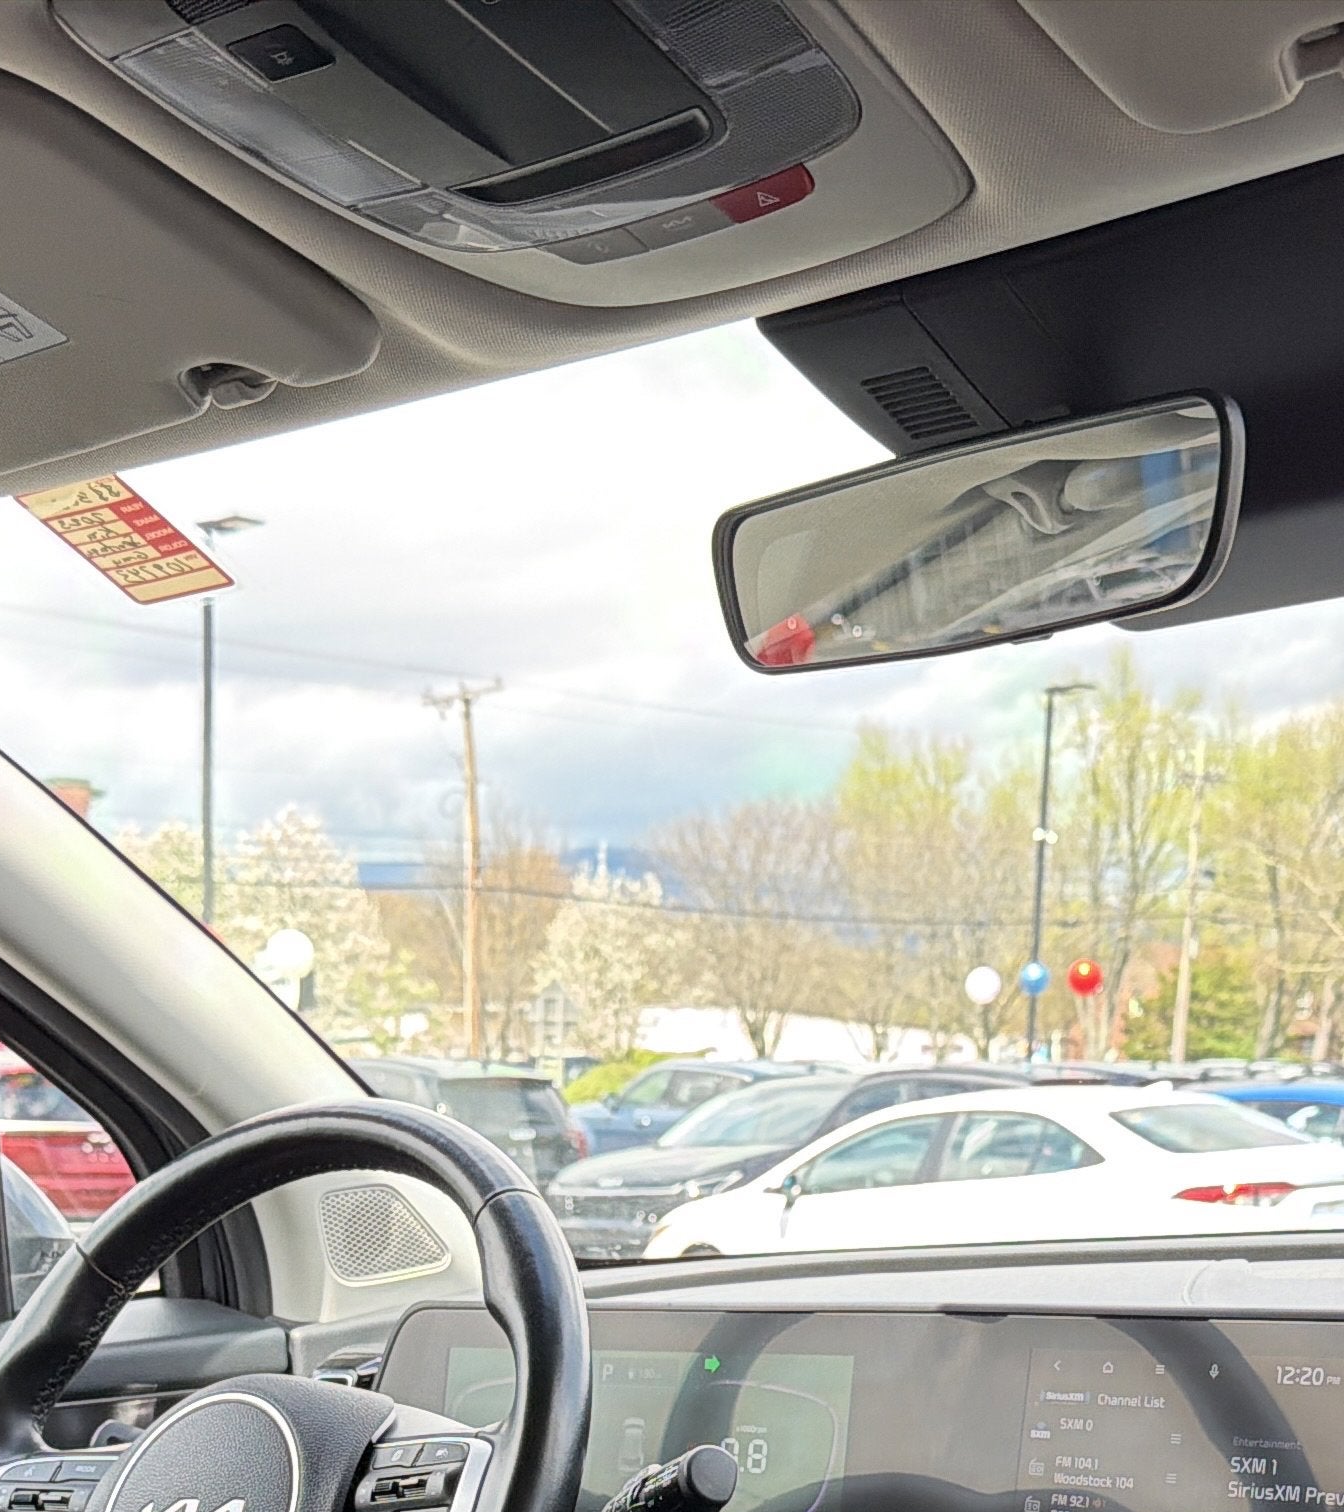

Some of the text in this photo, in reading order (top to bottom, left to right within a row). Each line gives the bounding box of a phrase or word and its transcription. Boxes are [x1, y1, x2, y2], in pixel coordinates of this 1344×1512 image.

[1276, 1366, 1325, 1386] 12:20
[1326, 1376, 1342, 1386] PM
[1097, 1393, 1142, 1408] Channel
[1144, 1395, 1166, 1409] List
[1060, 1417, 1084, 1431] SXM
[1232, 1435, 1303, 1451] Entertainment
[1055, 1455, 1099, 1471] FM 104.1
[1230, 1456, 1279, 1476] SXM 1
[1053, 1472, 1135, 1490] Woodstock 104
[1227, 1480, 1301, 1503] SiriusXM
[1050, 1493, 1068, 1507] FM
[1069, 1494, 1090, 1509] 92.1
